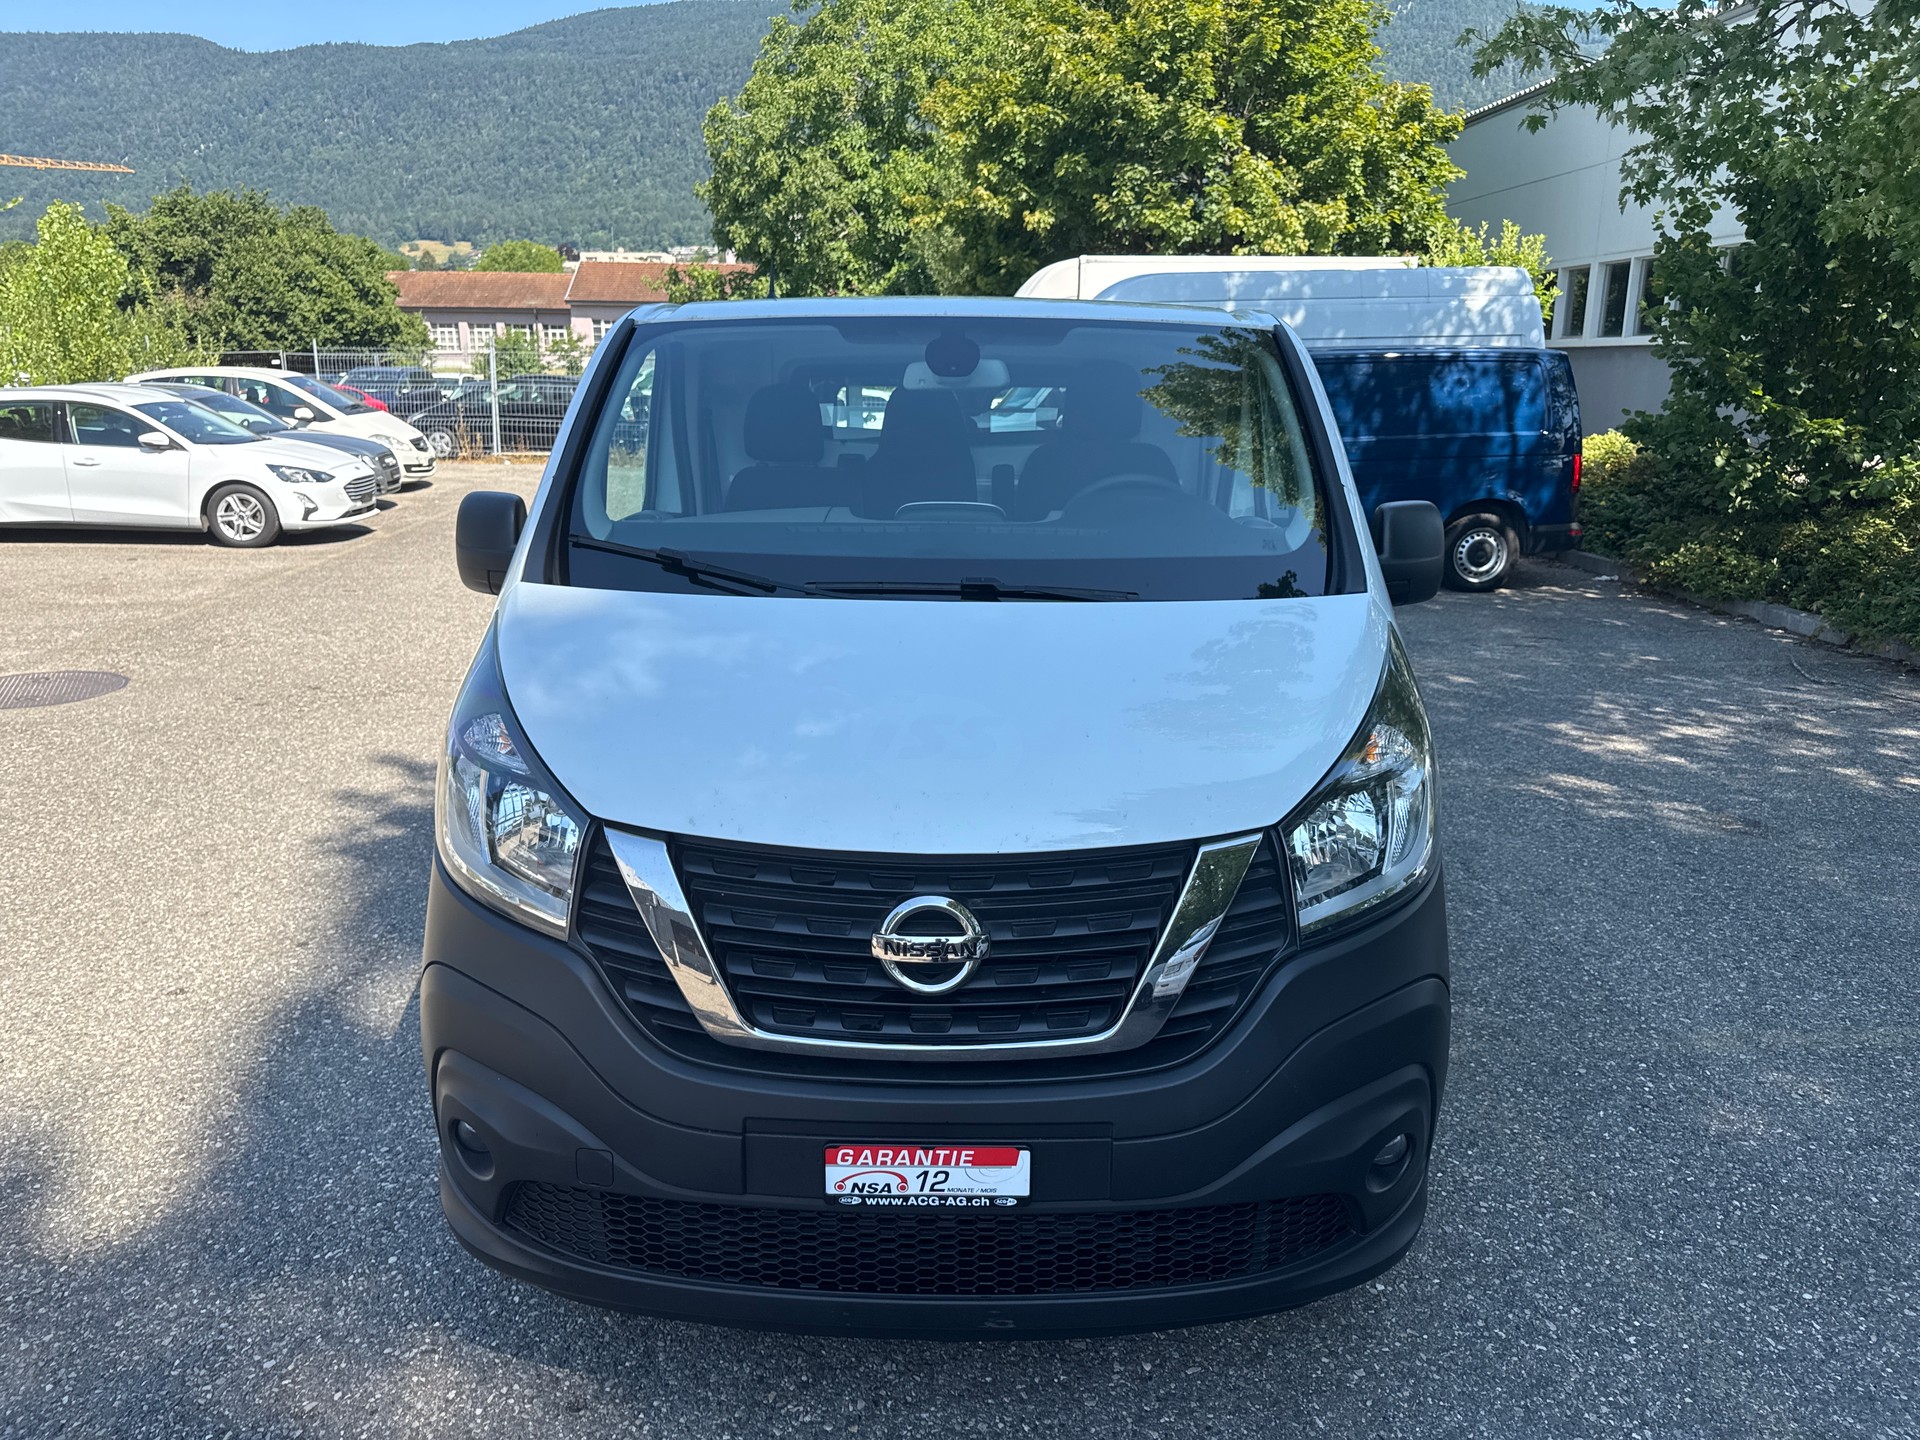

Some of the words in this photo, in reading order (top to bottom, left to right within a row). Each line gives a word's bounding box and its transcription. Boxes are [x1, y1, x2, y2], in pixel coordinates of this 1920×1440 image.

[883, 941, 978, 957] NISSAN
[836, 1148, 975, 1167] GARANTIE
[850, 1182, 892, 1194] NSA
[916, 1169, 950, 1193] 12
[865, 1195, 990, 1207] www.ACG-AG.ch
